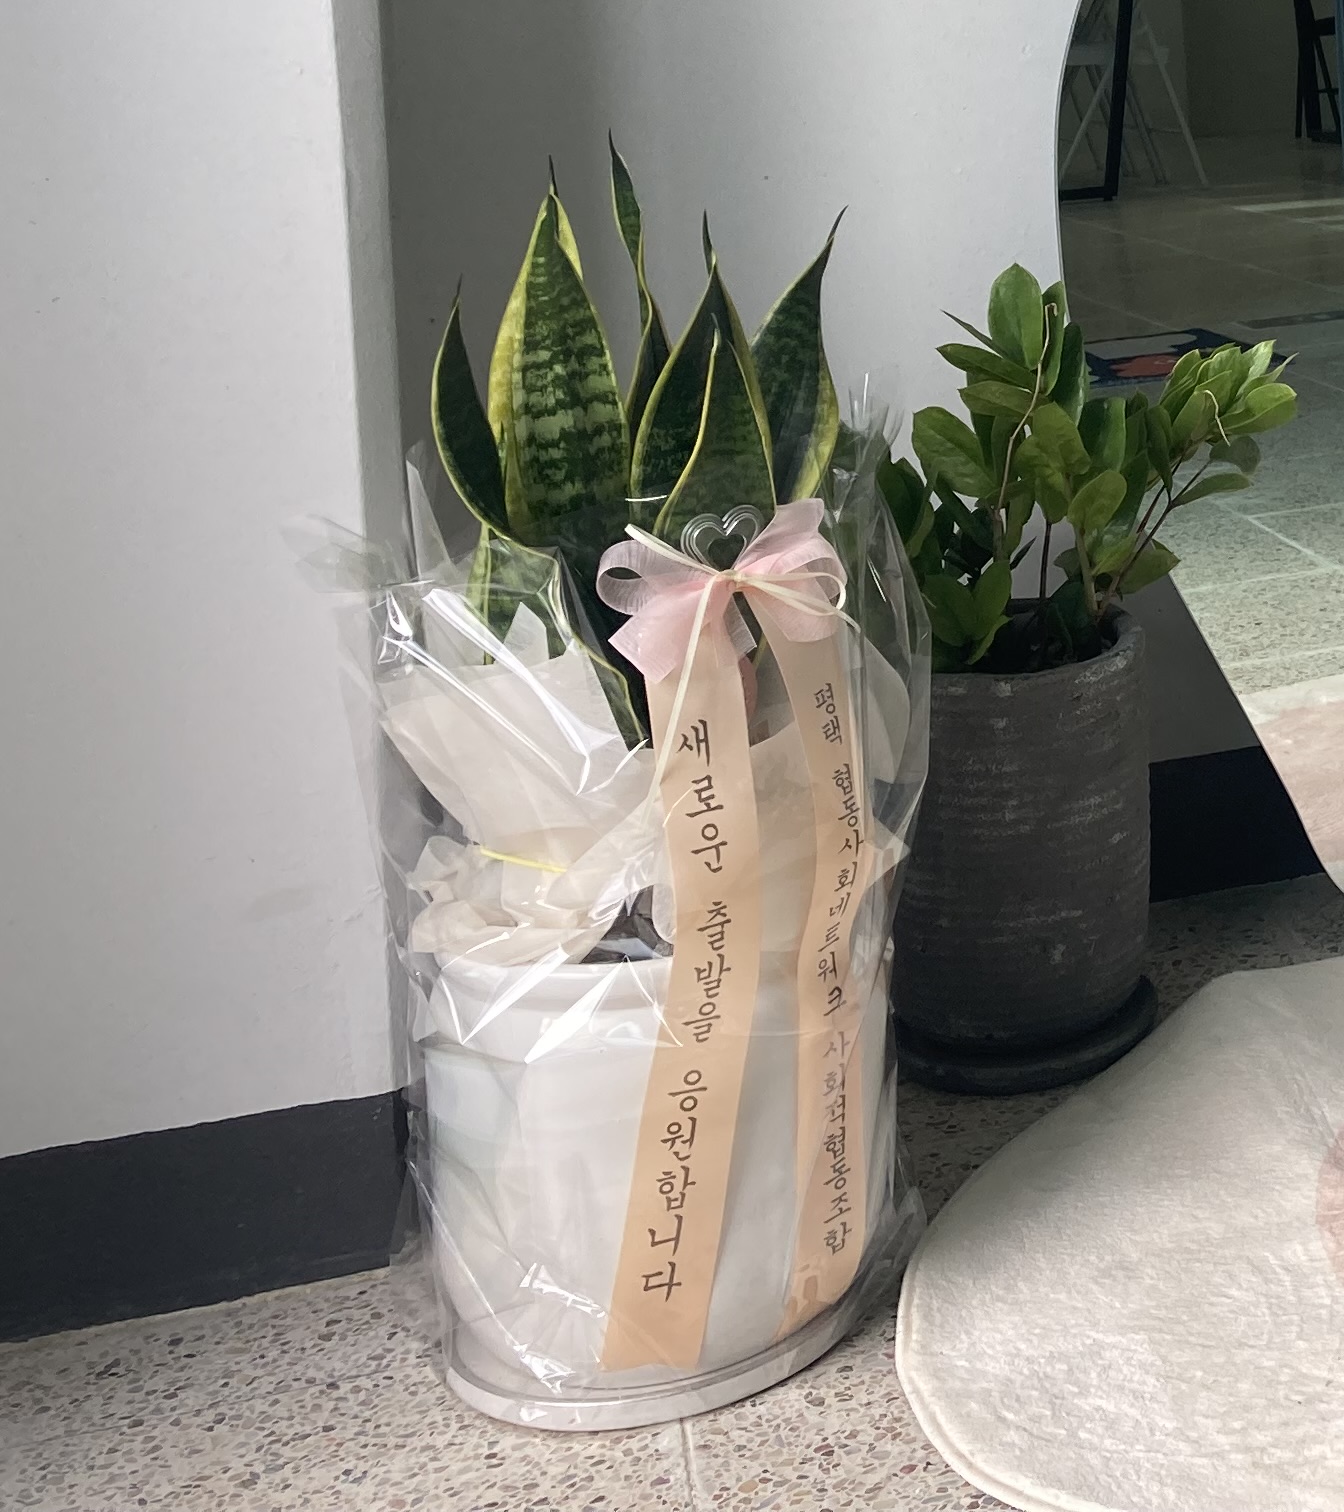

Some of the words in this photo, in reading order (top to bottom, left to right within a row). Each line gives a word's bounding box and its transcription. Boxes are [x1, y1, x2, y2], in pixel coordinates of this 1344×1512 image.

[813, 682, 843, 745] 평택
[675, 719, 731, 876] 새로운
[681, 901, 732, 1045] 출발을
[641, 1068, 707, 1304] 응원합니다
[822, 1031, 853, 1256] 사회적협동조합
